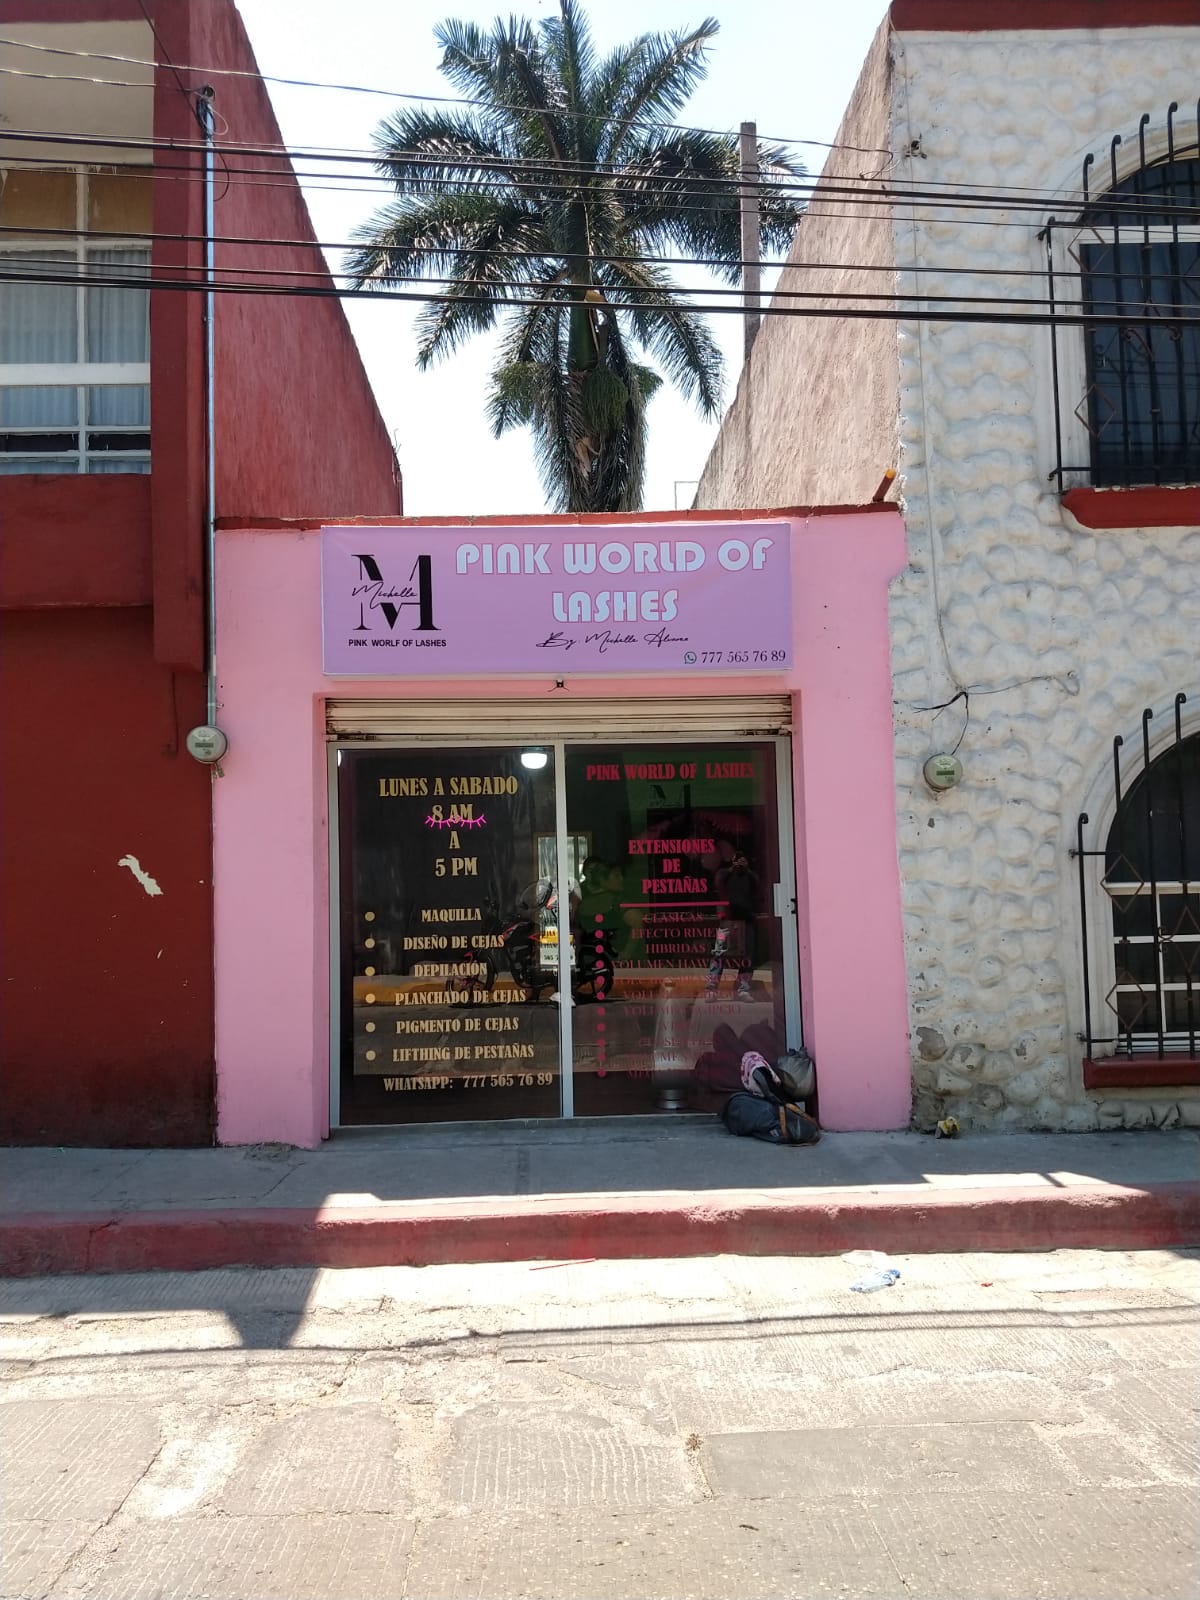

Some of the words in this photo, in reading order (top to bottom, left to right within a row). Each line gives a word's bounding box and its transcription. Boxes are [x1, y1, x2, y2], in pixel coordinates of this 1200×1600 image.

[455, 541, 551, 575] PINK
[563, 540, 706, 573] WORLD
[717, 538, 775, 571] OF
[351, 581, 418, 610] Michelle
[551, 589, 680, 624] LASHES
[348, 639, 368, 647] PINK
[371, 639, 401, 647] WORLF
[402, 639, 414, 647] OF
[415, 639, 447, 647] LASHES
[701, 651, 723, 664] 777
[726, 650, 749, 664] 565
[752, 650, 768, 663] 76
[770, 650, 786, 663] 89
[586, 765, 620, 781] PINK
[624, 763, 676, 780] WORLD
[679, 763, 697, 779] OF
[705, 762, 755, 779] LASHES
[378, 777, 429, 797] LUNES
[433, 777, 445, 796] A
[450, 775, 519, 796] SABADO
[431, 804, 444, 823] 8
[449, 803, 474, 823] AM
[449, 830, 461, 849] A
[628, 839, 715, 855] EXTENSIONES
[434, 859, 446, 877] 5
[451, 857, 479, 877] PM
[662, 859, 681, 874] DE
[641, 877, 708, 895] PESTAÑAS
[421, 908, 482, 923] MAQUILLA
[403, 934, 448, 951] DISEÑO
[452, 935, 468, 949] DE
[471, 934, 505, 949] CEJAS
[395, 991, 469, 1006] PLANCHADO
[473, 990, 489, 1004] DE
[492, 989, 527, 1003] CEJAS
[396, 1019, 461, 1034] PIGMENTO
[465, 1018, 481, 1032] DE
[485, 1017, 520, 1032] CEJAS
[392, 1047, 451, 1062] LIFTHING
[454, 1046, 471, 1060] DE
[474, 1041, 535, 1059] PESTAÑAS
[383, 1077, 454, 1092] WHATSAPP:
[463, 1074, 487, 1089] 777
[490, 1073, 514, 1087] 565
[518, 1073, 534, 1086] 76
[537, 1072, 553, 1086] 89
